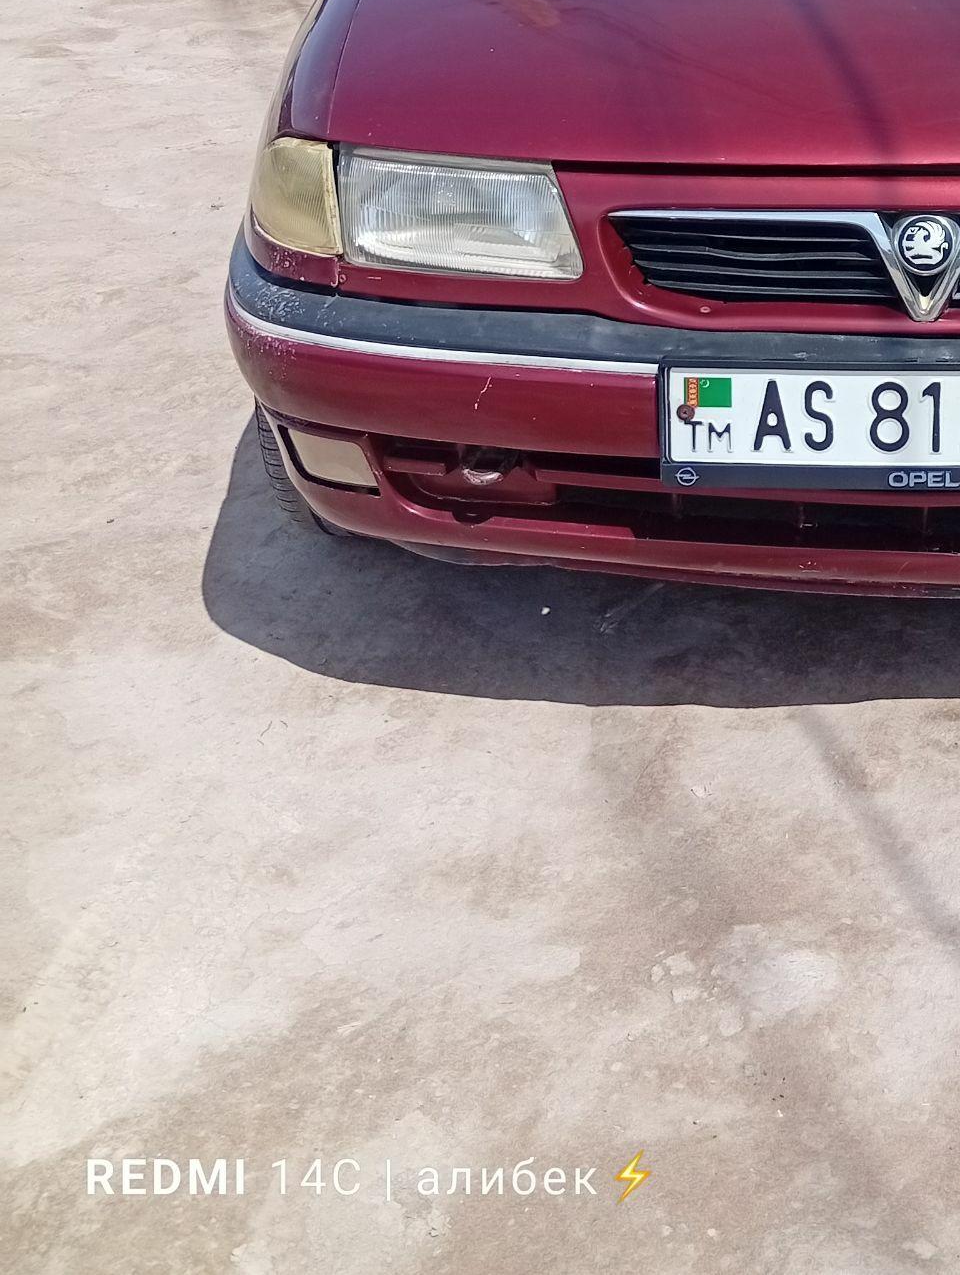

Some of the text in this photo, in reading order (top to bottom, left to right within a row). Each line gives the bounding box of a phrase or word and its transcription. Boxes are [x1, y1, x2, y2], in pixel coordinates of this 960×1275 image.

[684, 419, 733, 454] TM
[753, 378, 836, 453] AS
[888, 470, 960, 488] OPEL
